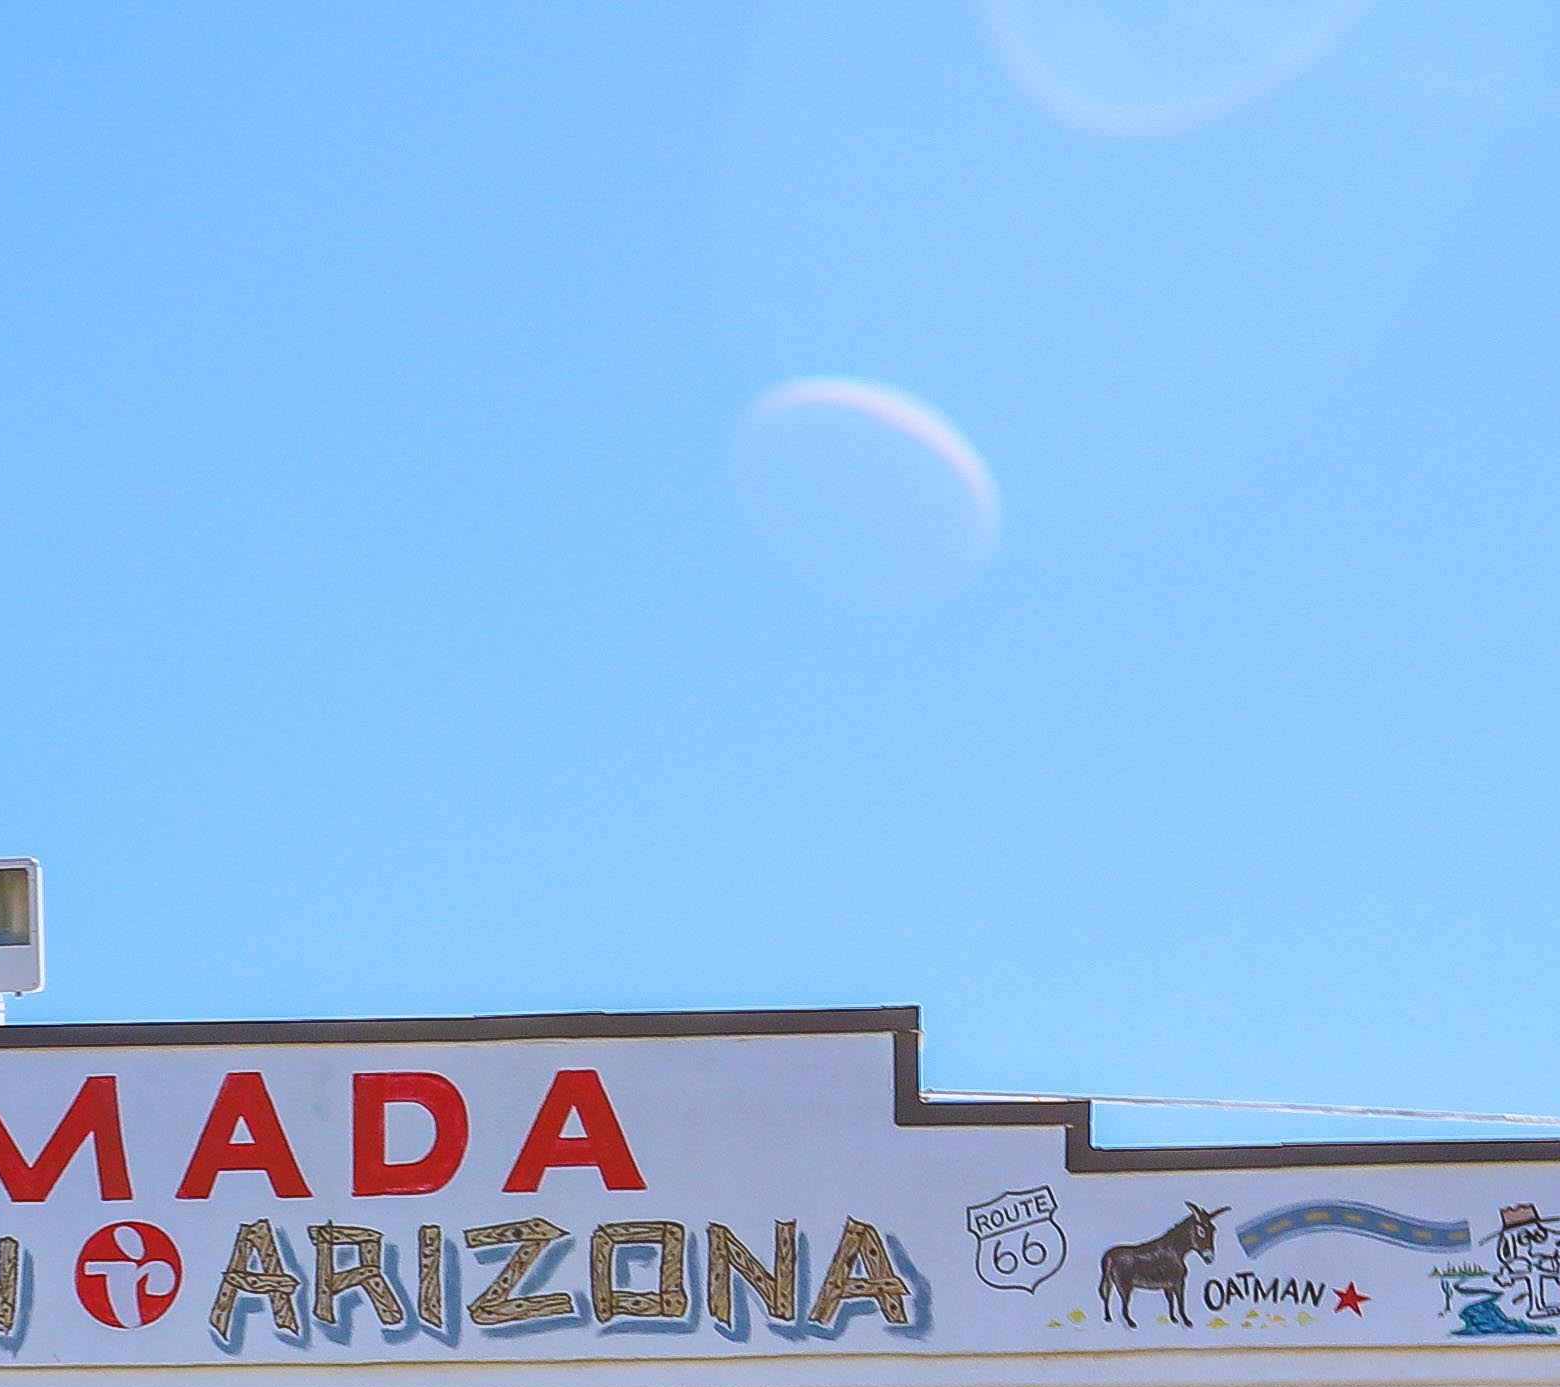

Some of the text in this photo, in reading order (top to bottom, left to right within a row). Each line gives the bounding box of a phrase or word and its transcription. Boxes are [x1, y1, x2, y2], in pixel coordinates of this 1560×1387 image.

[974, 1194, 1050, 1232] ROUTE
[992, 1230, 1048, 1275] 66
[209, 1215, 914, 1340] ARIZONA
[1204, 1272, 1326, 1312] OATMAN
